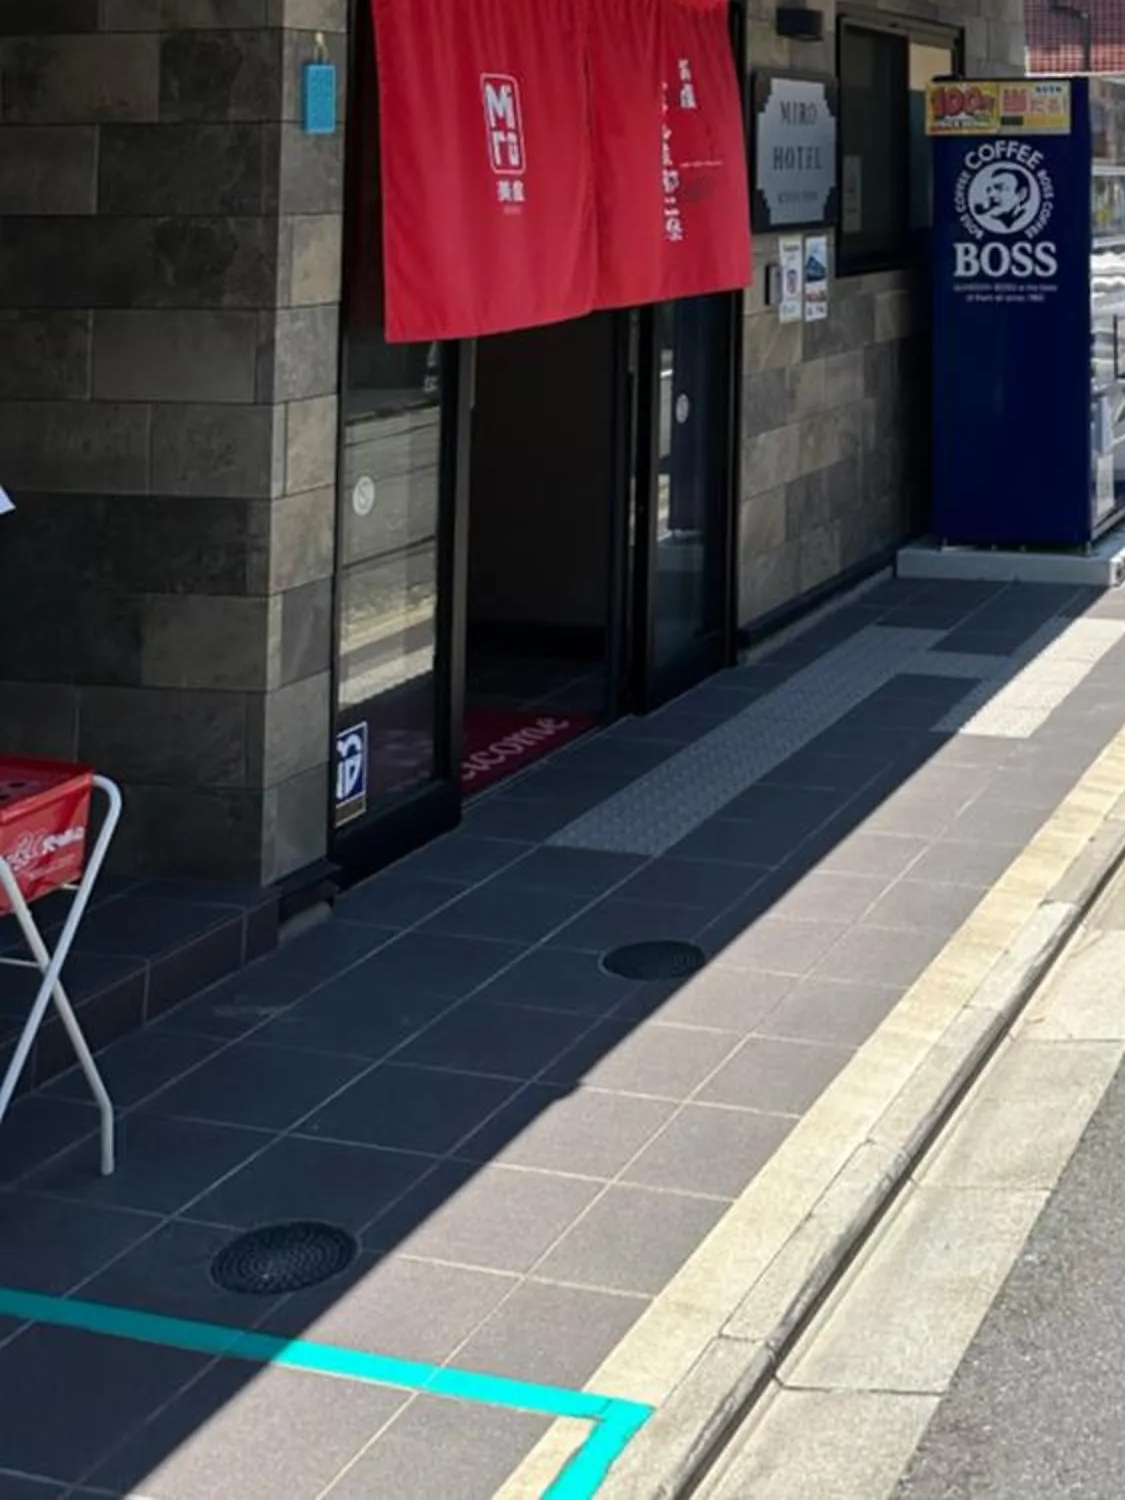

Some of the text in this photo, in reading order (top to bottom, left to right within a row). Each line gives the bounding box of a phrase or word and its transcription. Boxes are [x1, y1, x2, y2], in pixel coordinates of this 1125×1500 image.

[780, 101, 818, 125] MIRO
[773, 146, 823, 171] HOTEL
[965, 140, 1044, 170] COFFEE
[953, 242, 1058, 278] BOSS
